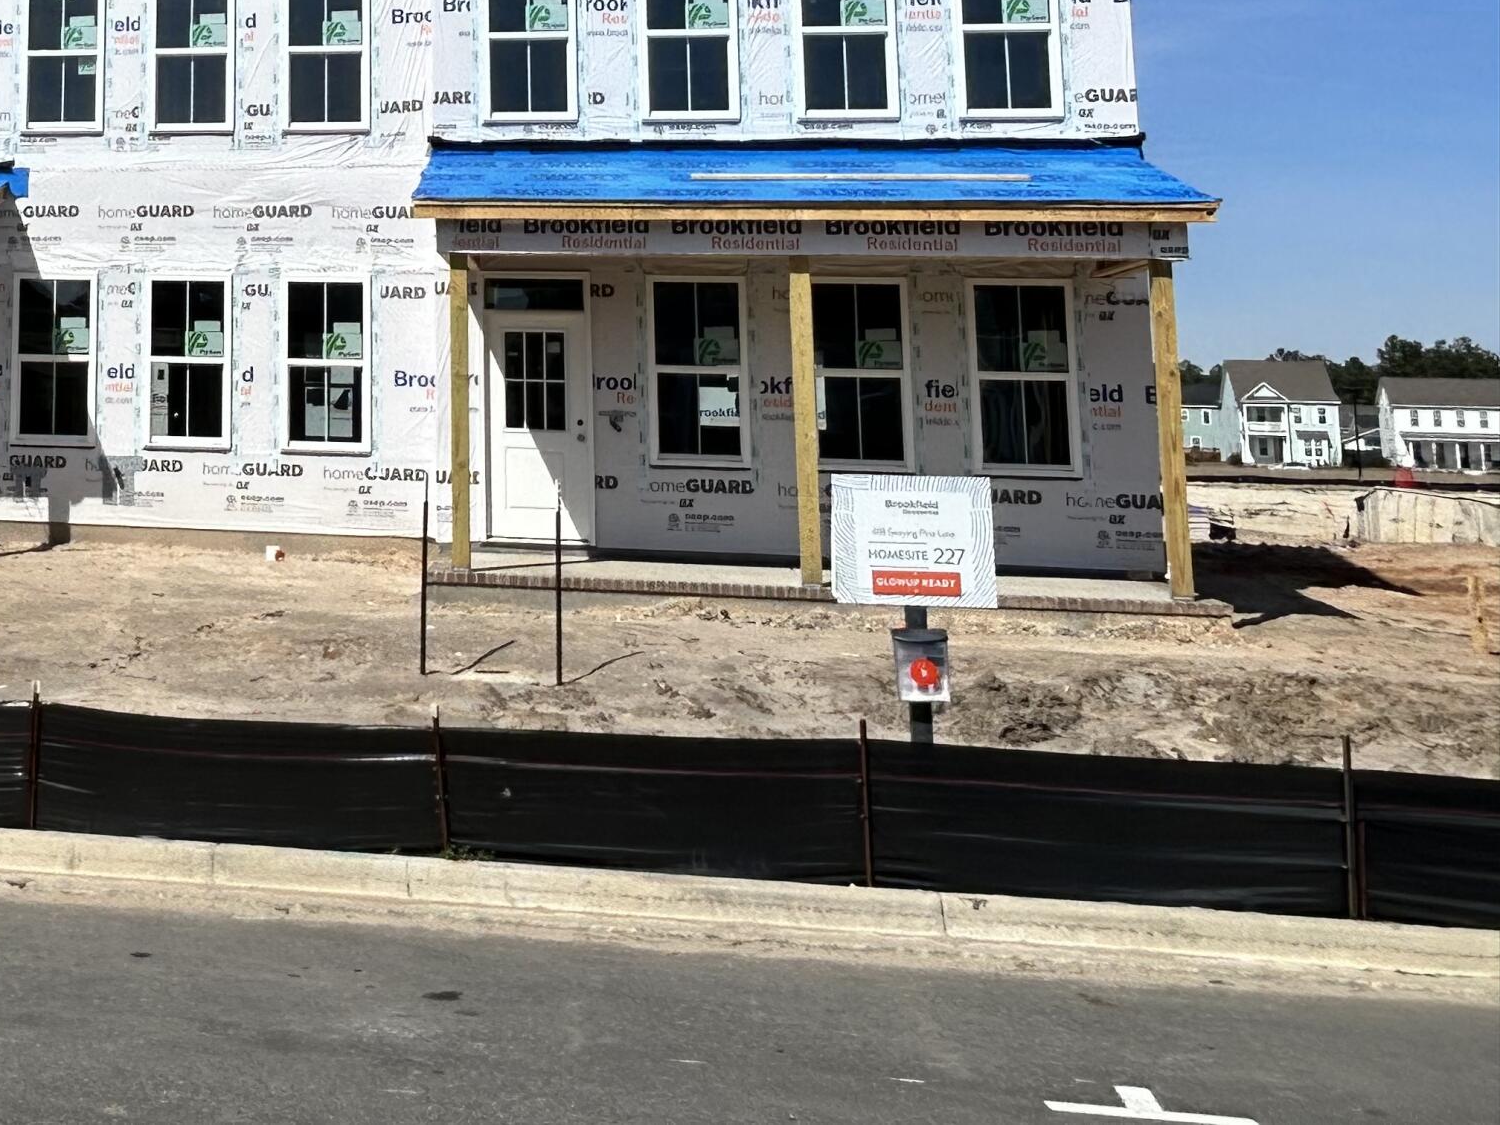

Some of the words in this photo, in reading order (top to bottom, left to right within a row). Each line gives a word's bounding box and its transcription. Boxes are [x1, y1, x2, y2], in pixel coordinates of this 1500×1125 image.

[98, 205, 195, 218] homeGUARD
[213, 205, 312, 219] homeGUARD
[523, 220, 649, 235] Brookfield
[671, 219, 802, 235] Brookfield
[825, 220, 960, 236] Brookfield
[984, 221, 1124, 237] Brookfield
[562, 236, 647, 250] Residential
[711, 236, 800, 251] Residential
[867, 236, 958, 252] Residential
[1028, 238, 1122, 254] Residential
[884, 499, 938, 509] Brookfield
[868, 549, 929, 561] HOMESITE
[933, 547, 965, 565] 227
[876, 577, 919, 587] GLOWUP
[921, 578, 956, 588] READY
